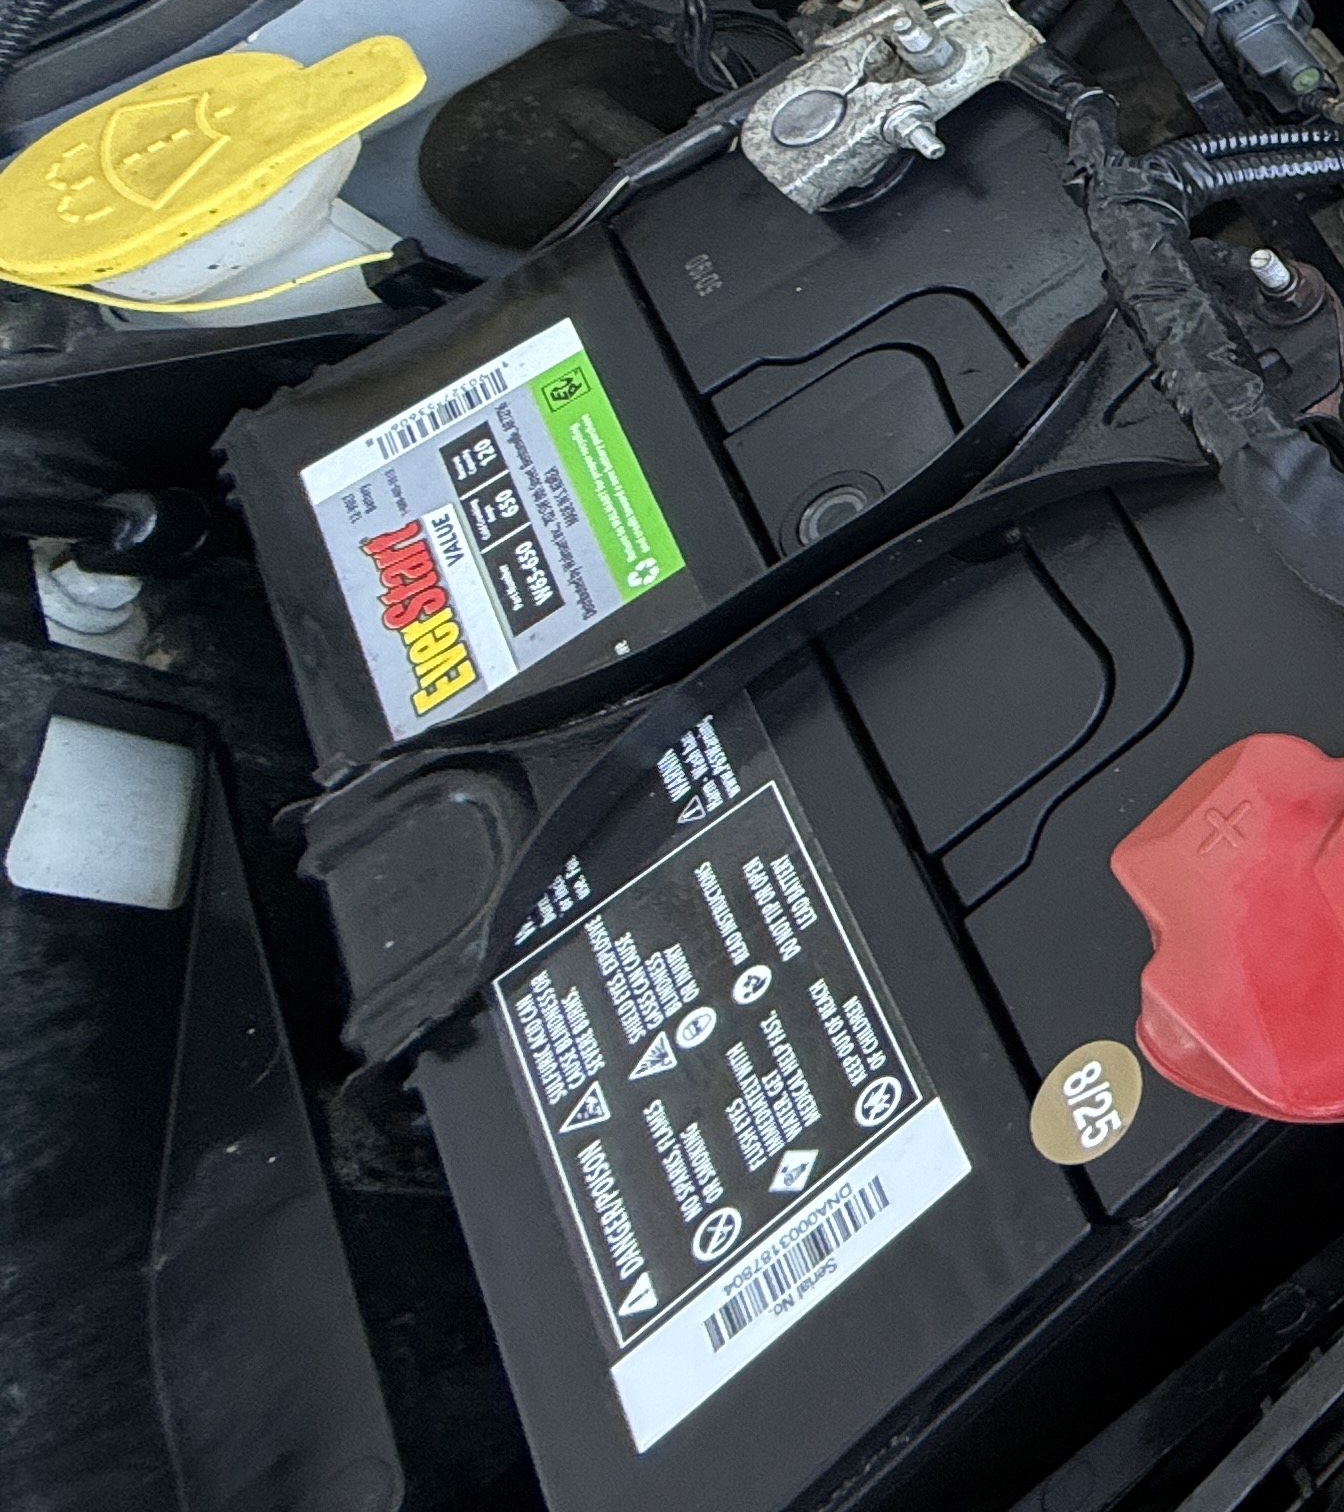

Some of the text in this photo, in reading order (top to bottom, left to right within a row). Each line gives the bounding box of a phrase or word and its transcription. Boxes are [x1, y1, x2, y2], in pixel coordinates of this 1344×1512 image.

[473, 439, 497, 466] 120
[431, 513, 465, 567] VALUE
[495, 489, 519, 518] 650
[515, 541, 553, 606] W65-650
[359, 518, 478, 718] EverStart
[694, 861, 750, 966] READ INSTRUCTIONS
[742, 856, 801, 962] DO NOT TIP OR OPEN
[770, 854, 818, 930] LEAD BATTERY
[584, 914, 620, 976] EXPLOSIVE
[614, 932, 664, 1032] GASES CAN CAUSE
[644, 952, 683, 1018] BLINDNESS
[663, 943, 700, 1003] OR INJURY
[515, 992, 568, 1105] SULFURIC ACID CAN
[530, 970, 587, 1093] CAUSE BLINDNESS OR
[561, 986, 606, 1076] SEVERE BURNS.
[616, 999, 647, 1045] SHIELD
[809, 978, 868, 1087] KEEP OUT OF REACH
[842, 995, 886, 1071] OF CHILDREN
[725, 1041, 786, 1159] IMMEDIATELY WITH
[760, 1009, 822, 1127] MEDICAL HELP FAST.
[761, 1069, 784, 1097] GET
[1064, 1060, 1122, 1148] 8/25
[643, 1099, 703, 1222] NO SPARKS, FLAMES
[679, 1122, 724, 1204] OR SMOKING
[725, 1097, 767, 1172] FLUSH EYES
[577, 1139, 645, 1280] DANGER/POISON
[722, 1181, 854, 1297] DNA0003187804
[767, 1255, 839, 1323] Serial No.
